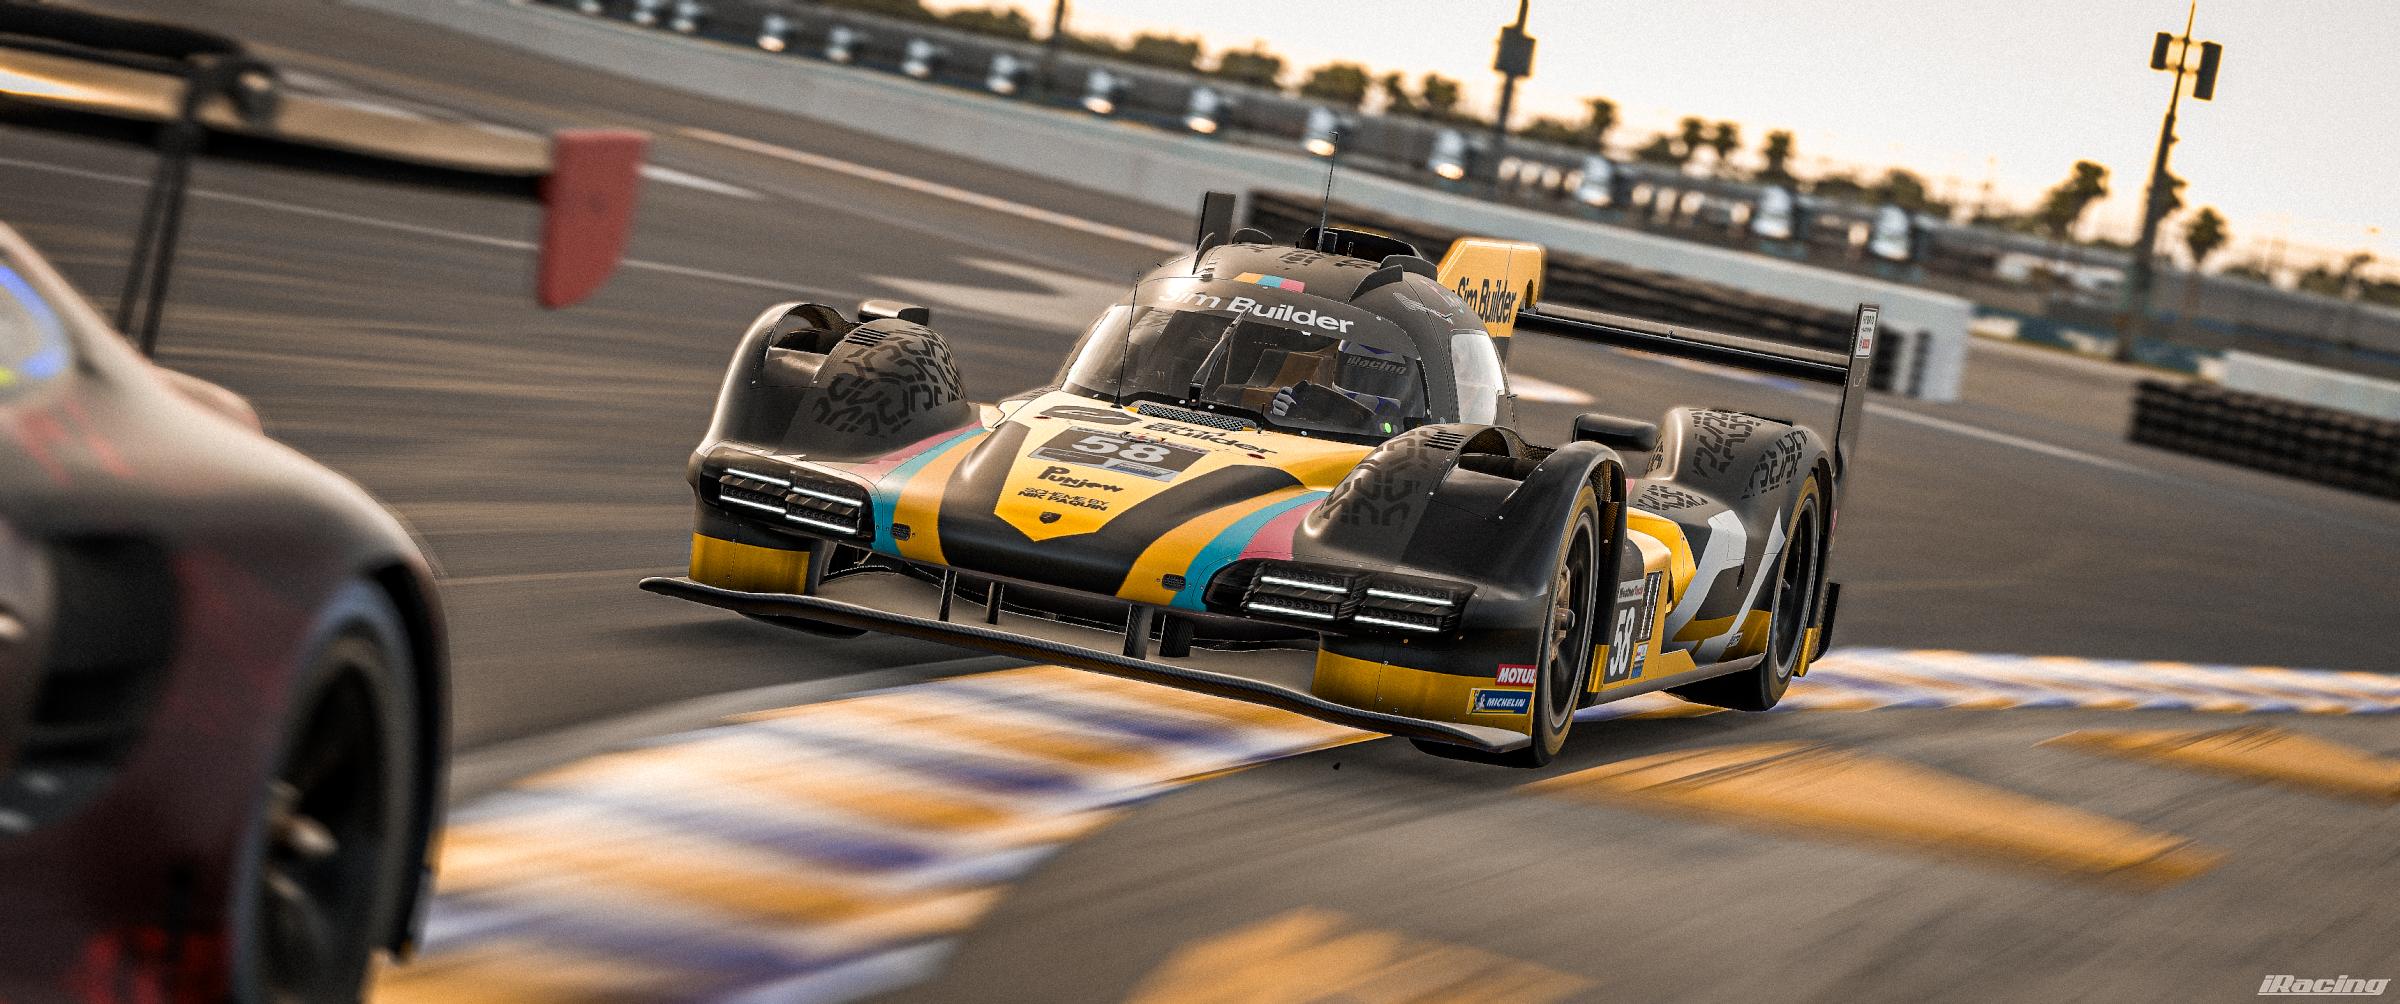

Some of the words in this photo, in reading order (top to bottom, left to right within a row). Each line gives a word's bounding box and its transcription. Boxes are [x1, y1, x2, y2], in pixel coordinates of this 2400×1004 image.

[1226, 296, 1354, 333] Builder
[1478, 278, 1517, 323] Builder
[1072, 435, 1171, 463] 58
[1609, 606, 1636, 677] 58
[1497, 667, 1536, 684] MOTUL
[1486, 697, 1526, 707] MICHELIN
